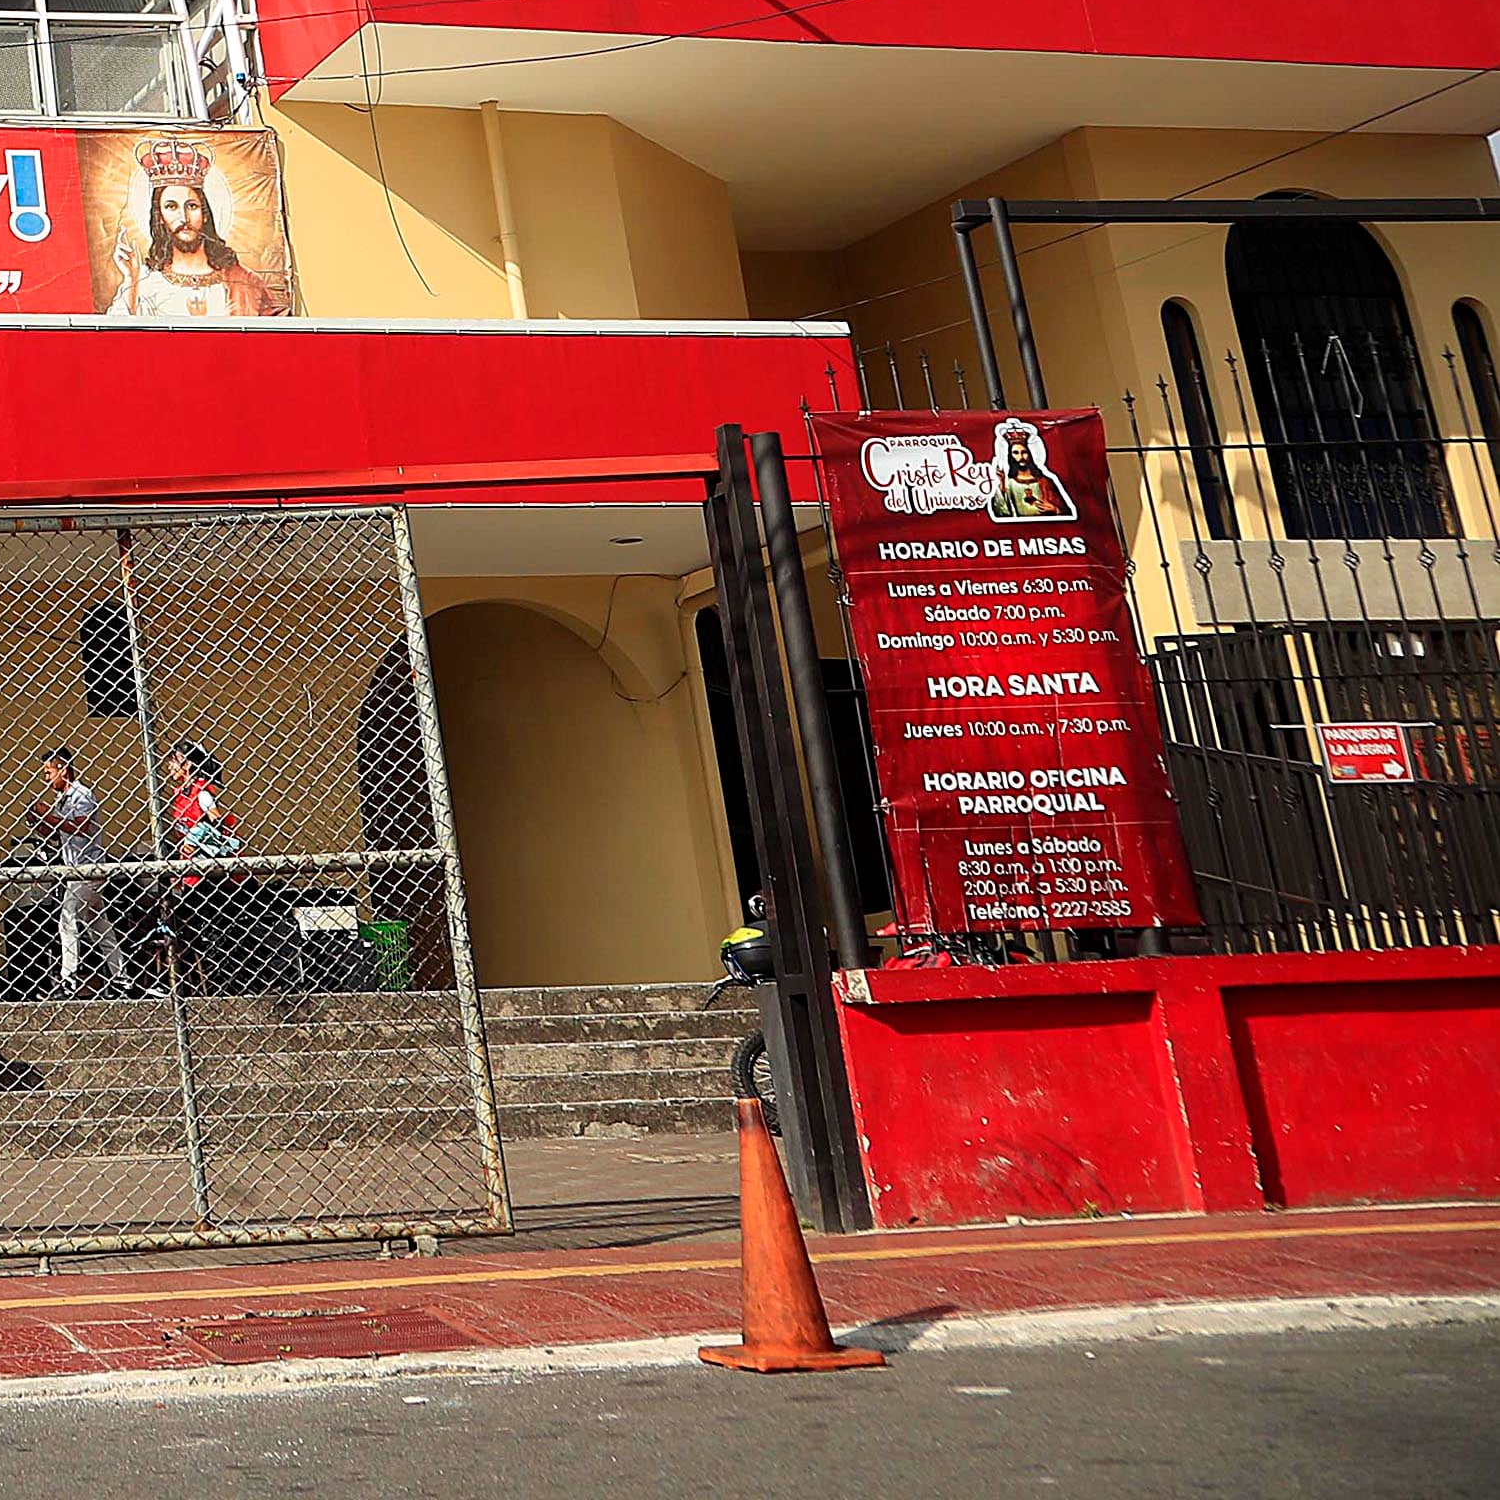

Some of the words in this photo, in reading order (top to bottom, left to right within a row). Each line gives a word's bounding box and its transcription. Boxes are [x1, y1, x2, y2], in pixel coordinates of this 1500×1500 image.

[890, 438, 957, 447] PARROQUIA
[865, 441, 946, 488] Cristo
[944, 448, 995, 494] Rey
[887, 488, 909, 510] del
[915, 488, 986, 511] Universo
[878, 540, 978, 560] HORARIO
[983, 539, 1015, 557] DE
[1019, 537, 1086, 556] MISAS
[888, 581, 936, 597] Lunes
[940, 584, 951, 596] a
[954, 579, 1018, 595] Viernes
[1022, 579, 1054, 594] 6:30
[1057, 578, 1094, 595] p.m.
[924, 604, 991, 622] Sábado
[993, 605, 1026, 620] 7:00
[1029, 605, 1065, 621] p.m.
[877, 631, 954, 650] Domingo
[959, 631, 998, 646] 10:00
[1001, 634, 1036, 646] a.m.
[1039, 632, 1048, 646] y
[1052, 628, 1085, 644] 5:30
[1088, 628, 1120, 644] p.m.
[927, 676, 1004, 698] HORA
[1008, 672, 1100, 696] SANTA
[903, 721, 963, 739] Jueves
[968, 721, 1006, 737] 10:00
[1009, 722, 1044, 735] a.m.
[1046, 722, 1055, 737] y
[1059, 718, 1093, 734] 7:30
[1096, 717, 1131, 734] p.m.
[1322, 727, 1380, 742] PARQUEO
[1378, 727, 1397, 740] DE
[1328, 744, 1347, 756] LA
[923, 770, 1025, 792] HORARIO
[1030, 766, 1127, 789] OFICINA
[958, 792, 1105, 816] PARROQUIAL
[964, 840, 1012, 856] Lunes
[1017, 842, 1030, 855] a
[1032, 836, 1101, 855] Sábado
[958, 860, 990, 876] 8:30
[994, 862, 1028, 875] a.m.
[1032, 862, 1045, 874] a
[1049, 858, 1081, 873] 1:00
[1085, 858, 1122, 875] p.m.
[964, 880, 996, 896] 2:00
[999, 881, 1034, 897] p.m.
[1038, 882, 1051, 894] a
[1055, 878, 1086, 893] 5:30
[1090, 878, 1128, 895] p.m.
[1051, 901, 1131, 917] 2227-2585
